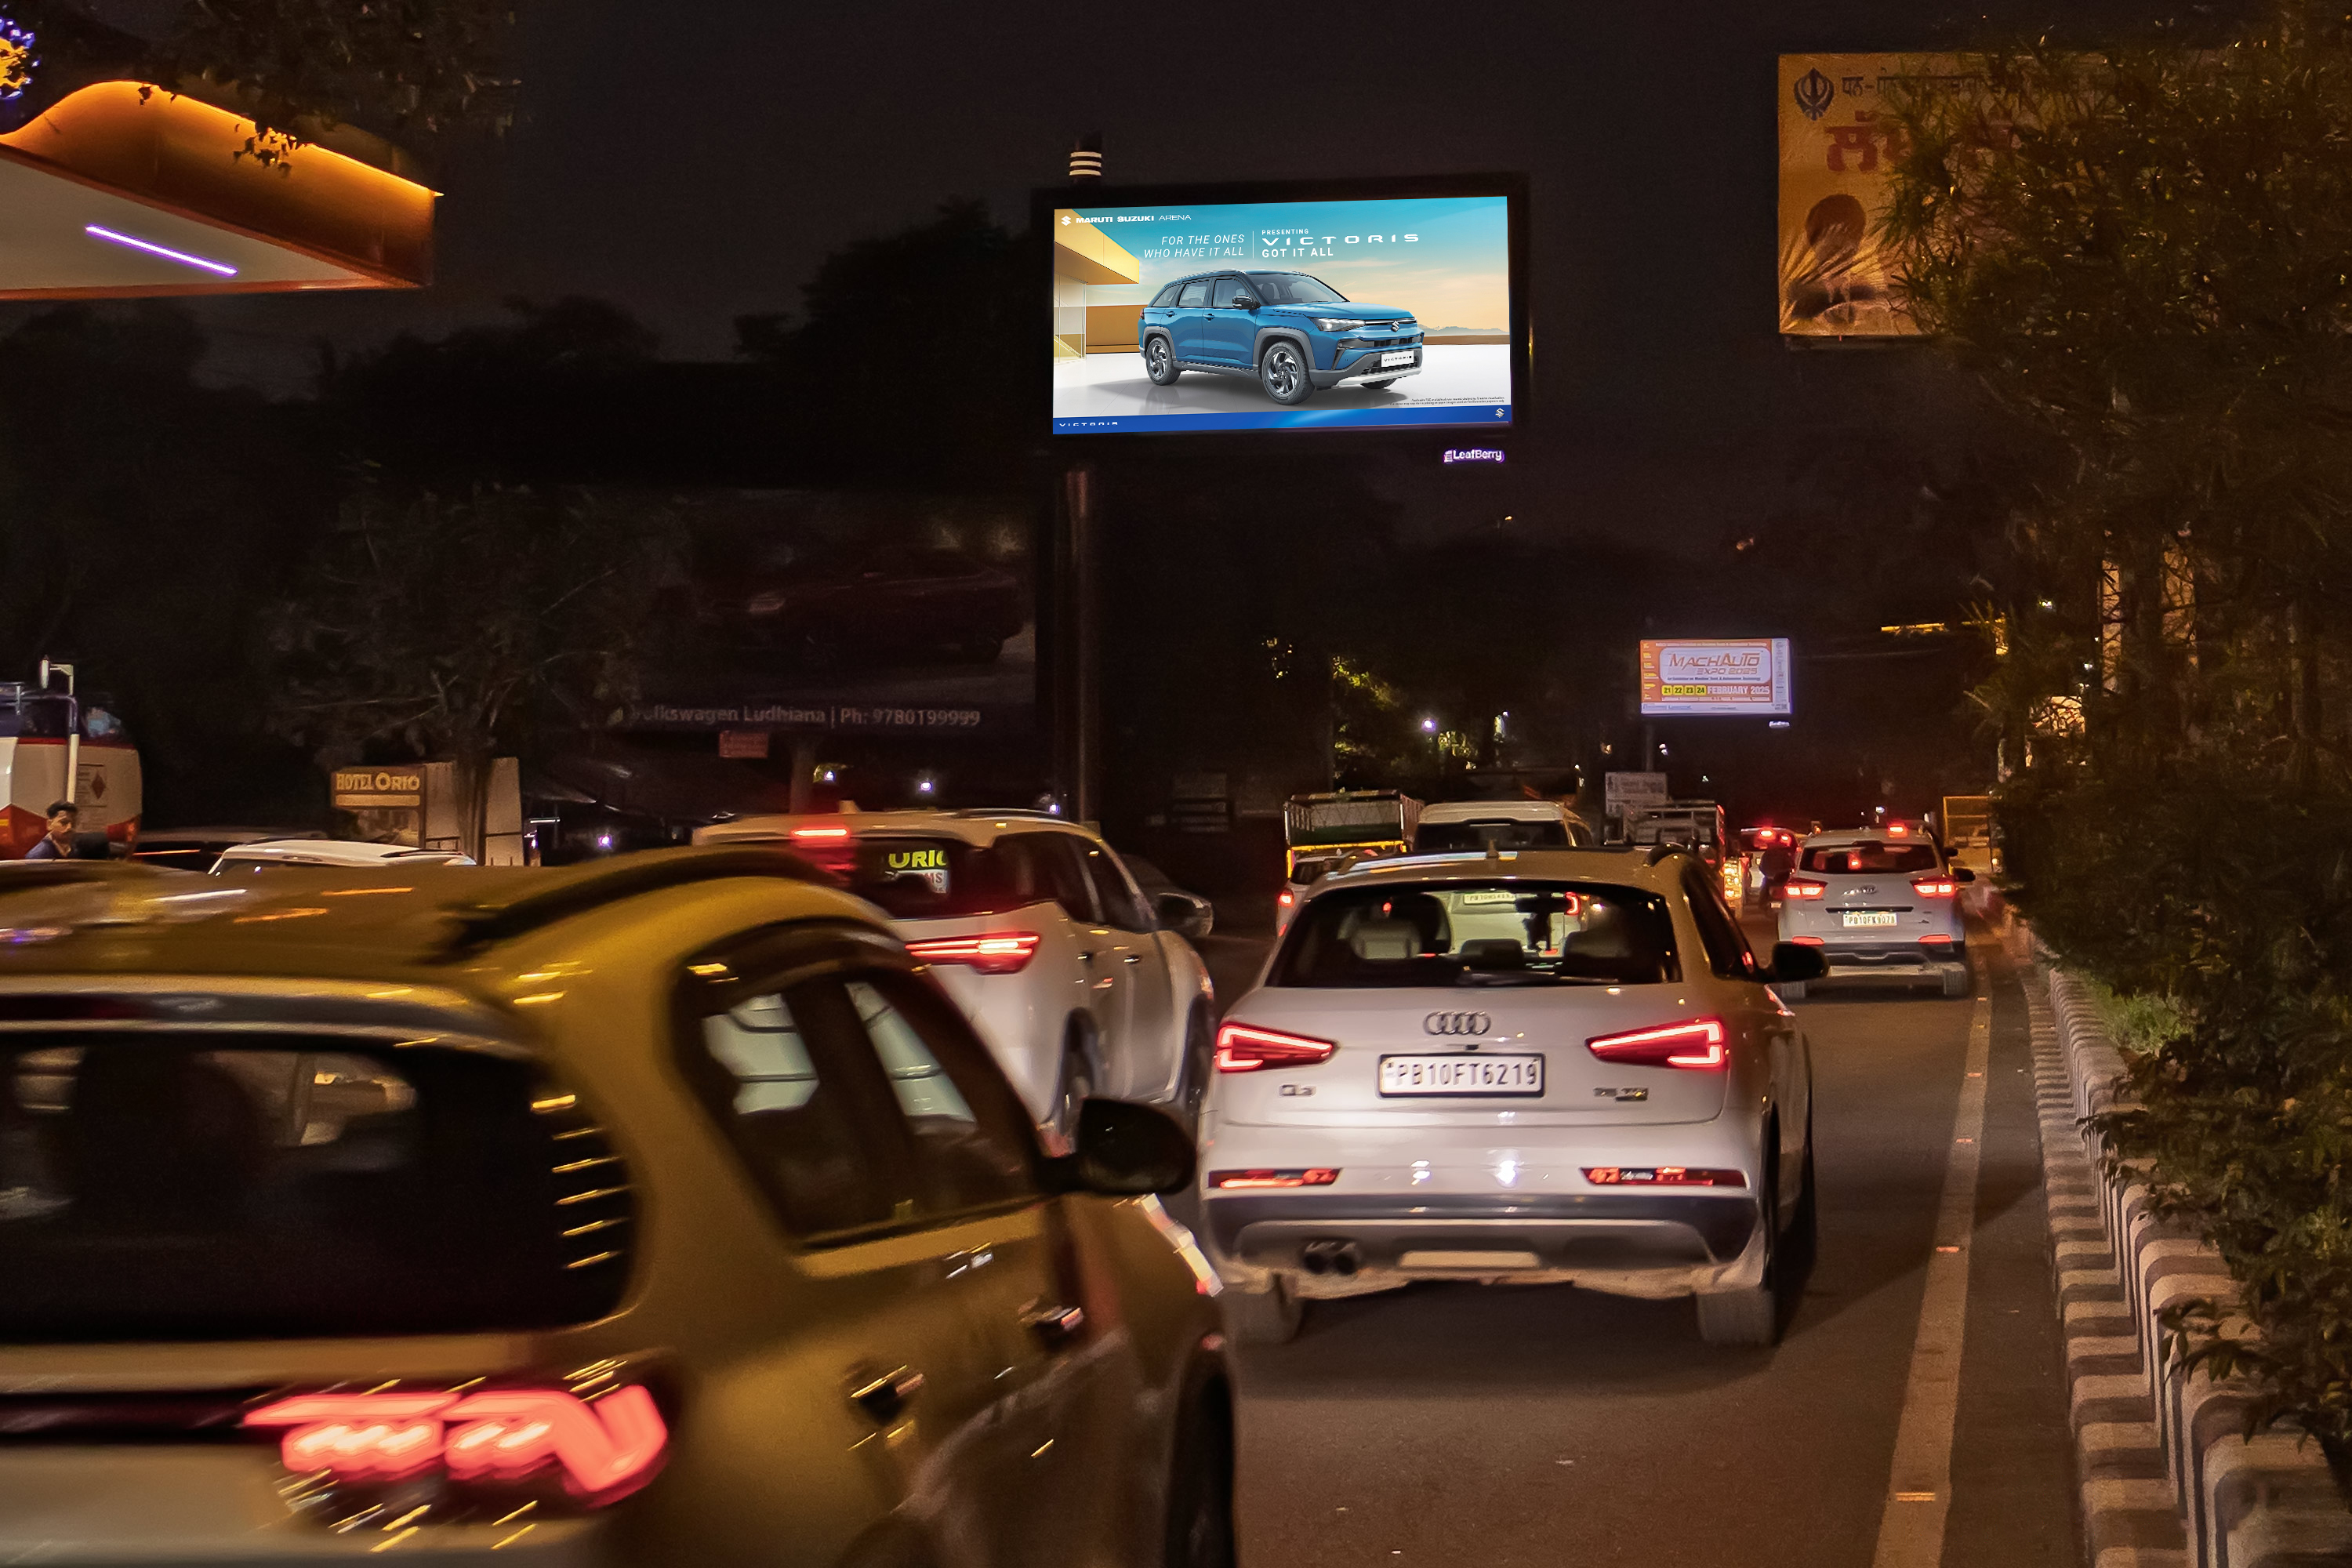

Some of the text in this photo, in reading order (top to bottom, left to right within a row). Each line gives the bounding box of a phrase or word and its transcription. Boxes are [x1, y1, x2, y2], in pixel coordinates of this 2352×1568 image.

[1161, 234, 1245, 245] FOR THE ONES
[1261, 234, 1419, 246] VICTORIS
[1144, 246, 1244, 259] WHO HAVE IT ALL
[1261, 247, 1334, 258] GOT IT ALL
[1453, 448, 1503, 462] LeafBerry
[1708, 686, 1748, 695] FEBRUARY
[743, 705, 826, 723] Ludhiana
[1396, 1062, 1537, 1086] PB10FT6219
